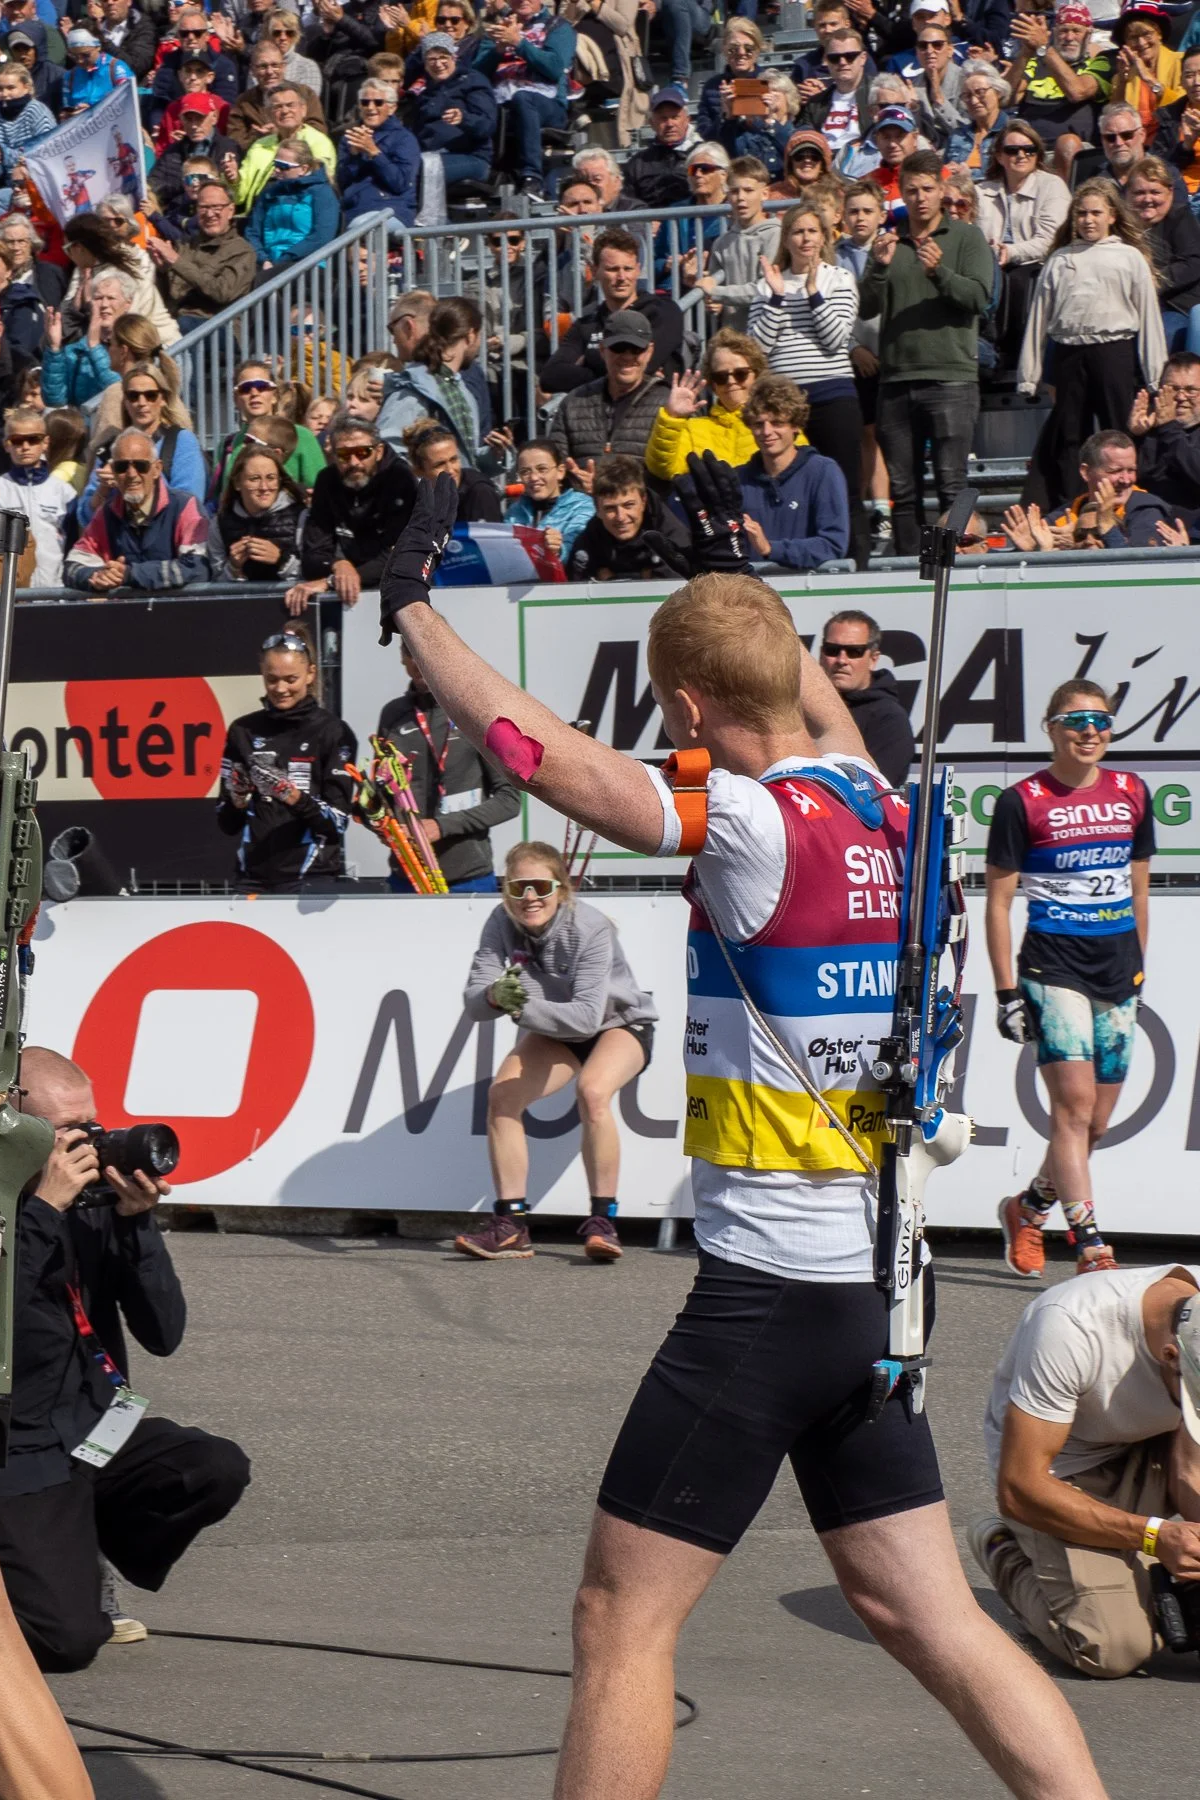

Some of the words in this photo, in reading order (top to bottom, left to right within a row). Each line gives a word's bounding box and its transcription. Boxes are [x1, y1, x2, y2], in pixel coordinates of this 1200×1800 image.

[1088, 874, 1116, 897] 22
[808, 1034, 864, 1058] Øster
[824, 1055, 857, 1076] Hus
